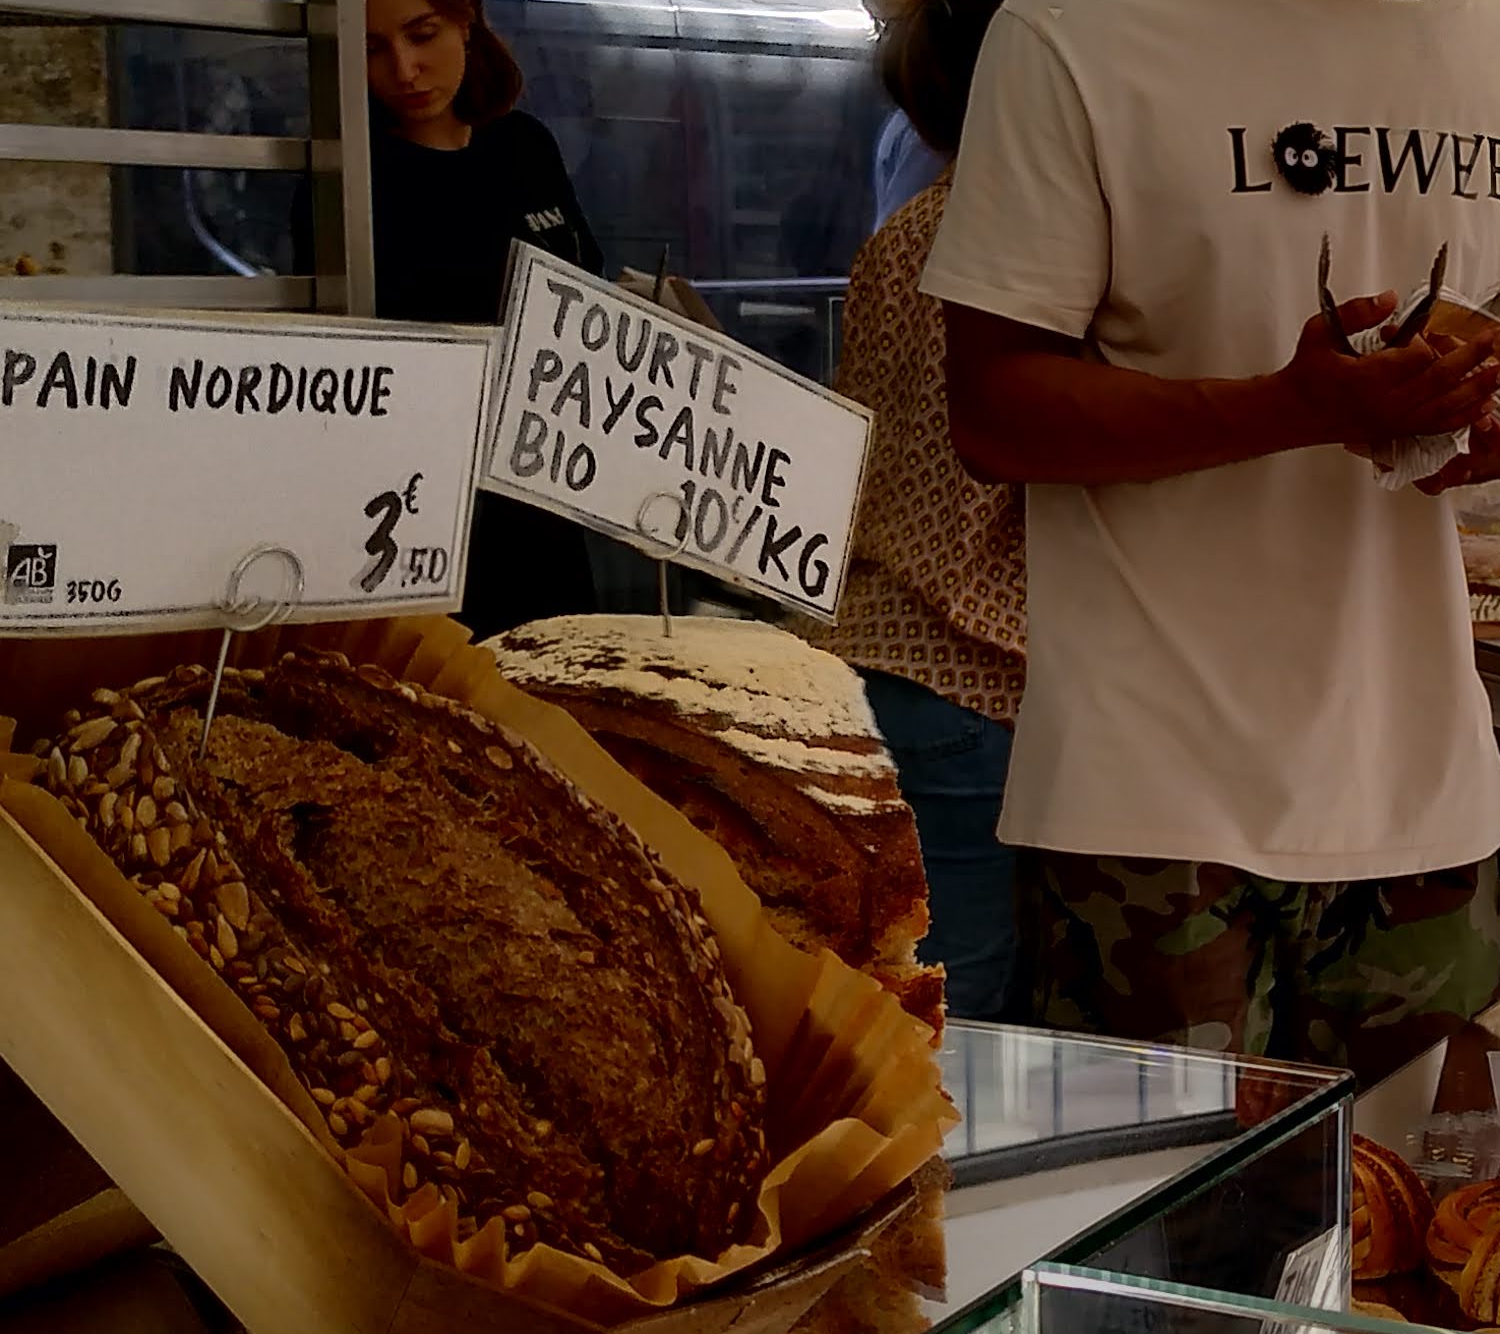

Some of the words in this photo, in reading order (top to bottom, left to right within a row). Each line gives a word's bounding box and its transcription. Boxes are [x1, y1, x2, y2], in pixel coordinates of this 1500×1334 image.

[2, 349, 136, 409] PAIN
[169, 359, 394, 416] NORDIQUE
[548, 279, 742, 415] TOURTE
[510, 410, 596, 491] BIO
[528, 349, 790, 507] PAYSANNE
[66, 579, 122, 603] 350G
